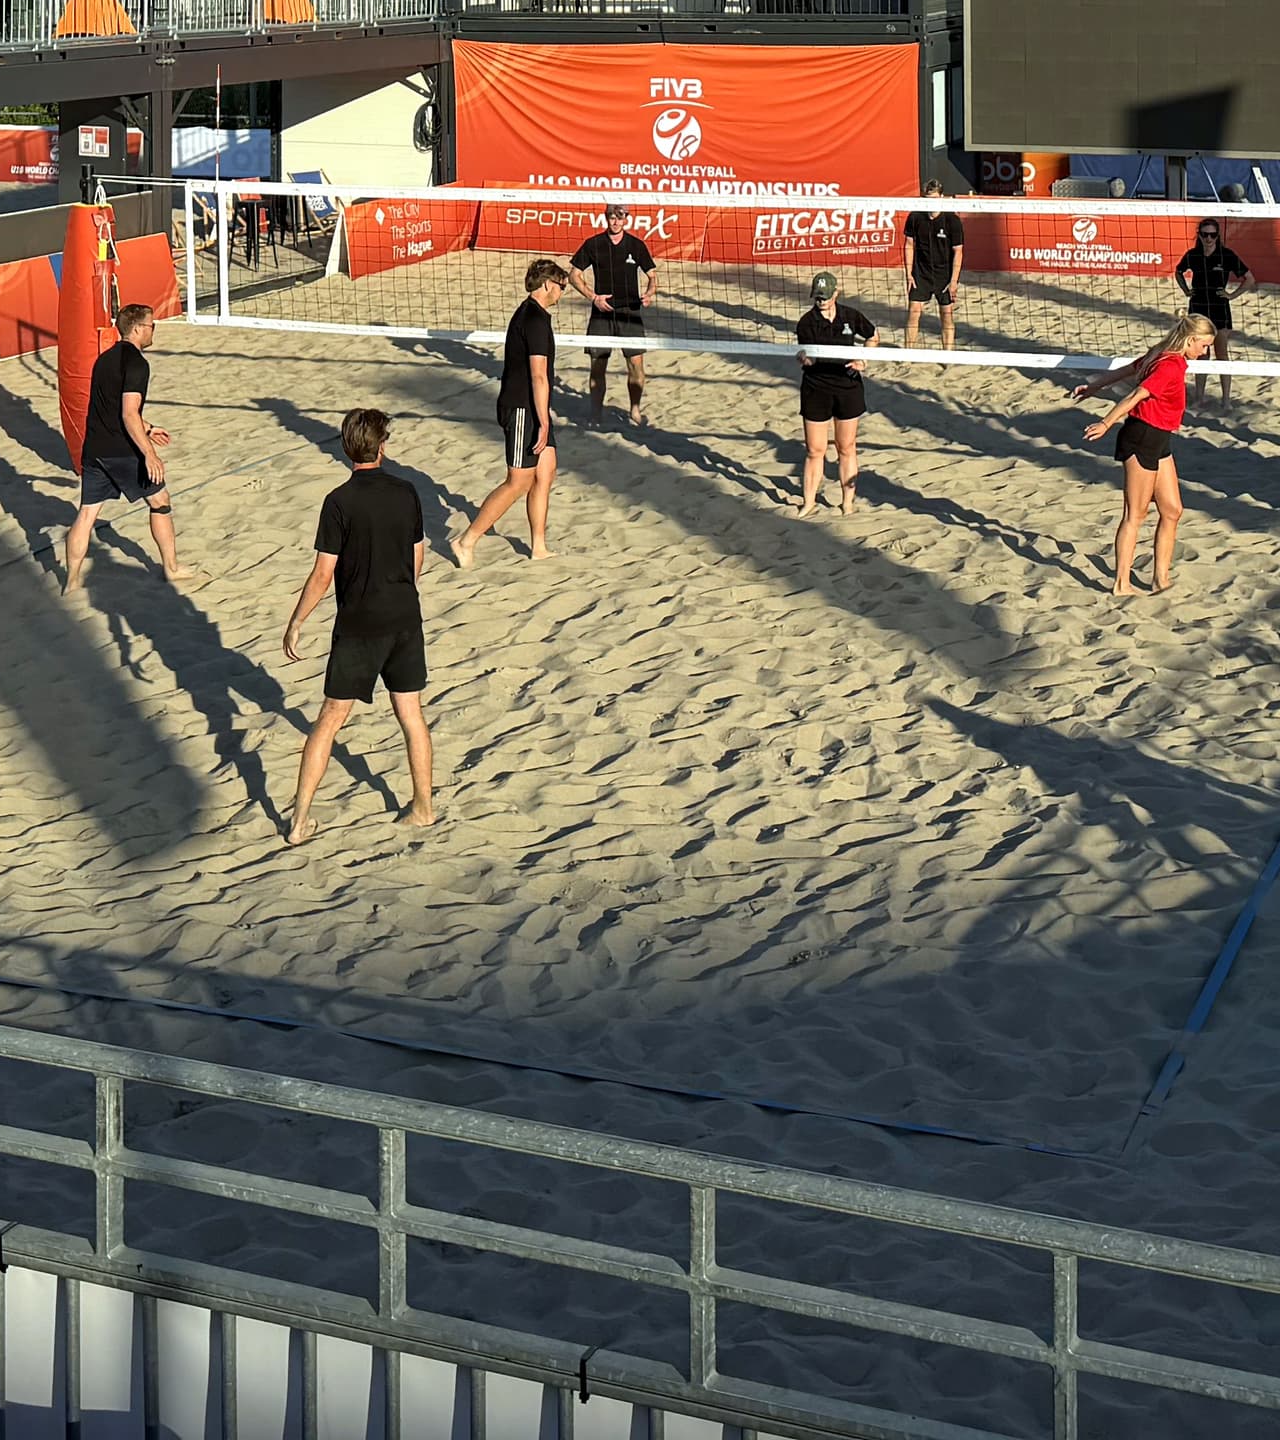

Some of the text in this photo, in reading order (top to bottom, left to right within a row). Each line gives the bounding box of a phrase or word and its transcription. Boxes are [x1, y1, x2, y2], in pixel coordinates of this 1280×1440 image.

[650, 77, 703, 99] FIVB
[620, 163, 737, 178] BEACH VOLLEYBALL
[388, 201, 420, 219] The City
[391, 220, 432, 240] The Sports
[755, 209, 896, 237] FITCASTER
[757, 232, 890, 250] DIGITAL SIGNAGE
[392, 245, 406, 259] The
[1010, 247, 1162, 264] U18 WORLD CHAMPIONSHIPS
